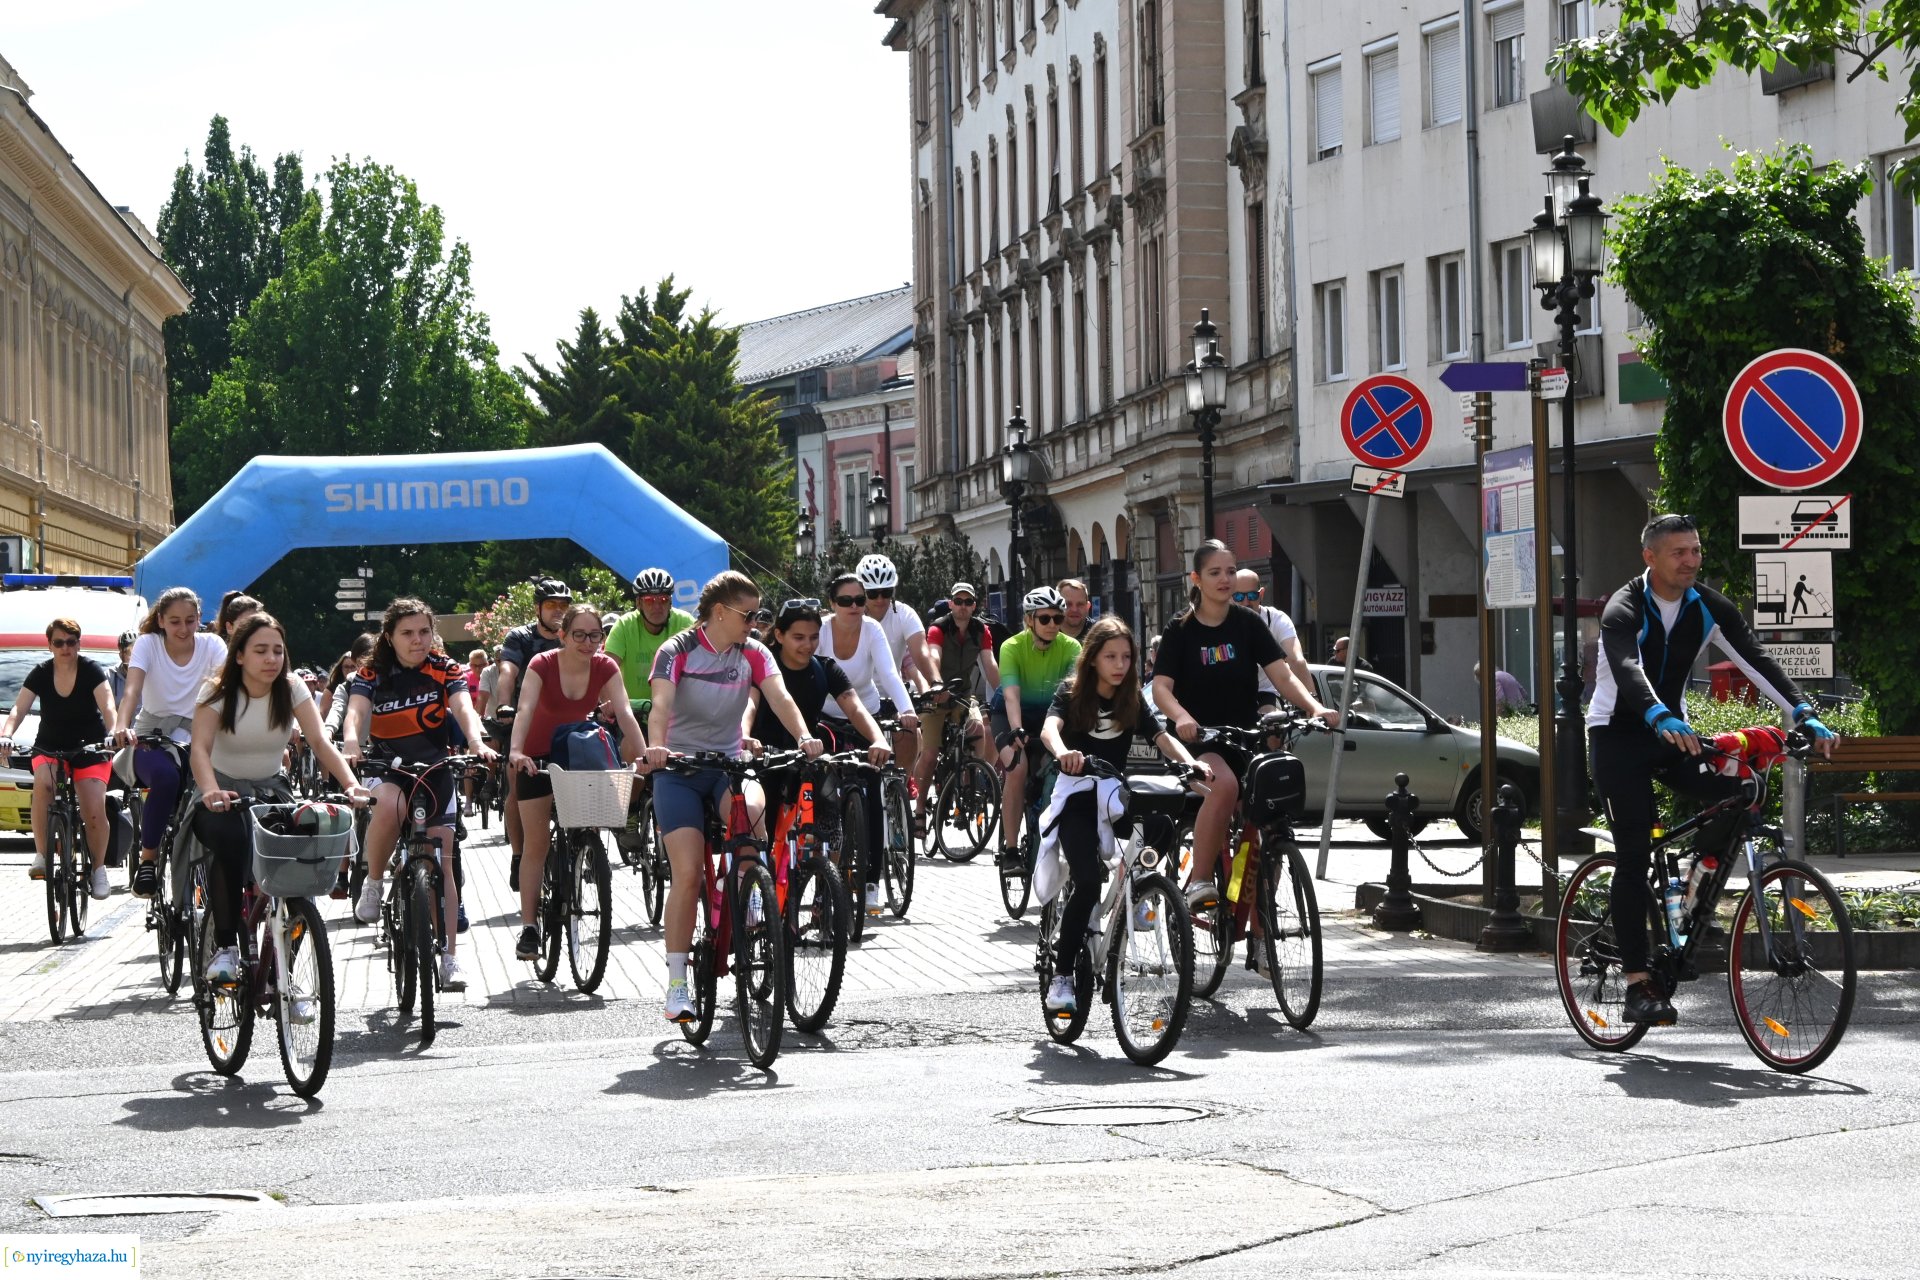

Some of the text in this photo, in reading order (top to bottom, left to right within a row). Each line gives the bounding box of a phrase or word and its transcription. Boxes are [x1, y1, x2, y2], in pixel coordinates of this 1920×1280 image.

[324, 477, 530, 512] SHIMANO
[1364, 590, 1404, 602] VIGYÁZZ
[1769, 645, 1821, 656] KIZÁRÓLAG
[1776, 656, 1820, 666] TKEZELŐI
[1783, 666, 1828, 676] DÉLLYEL
